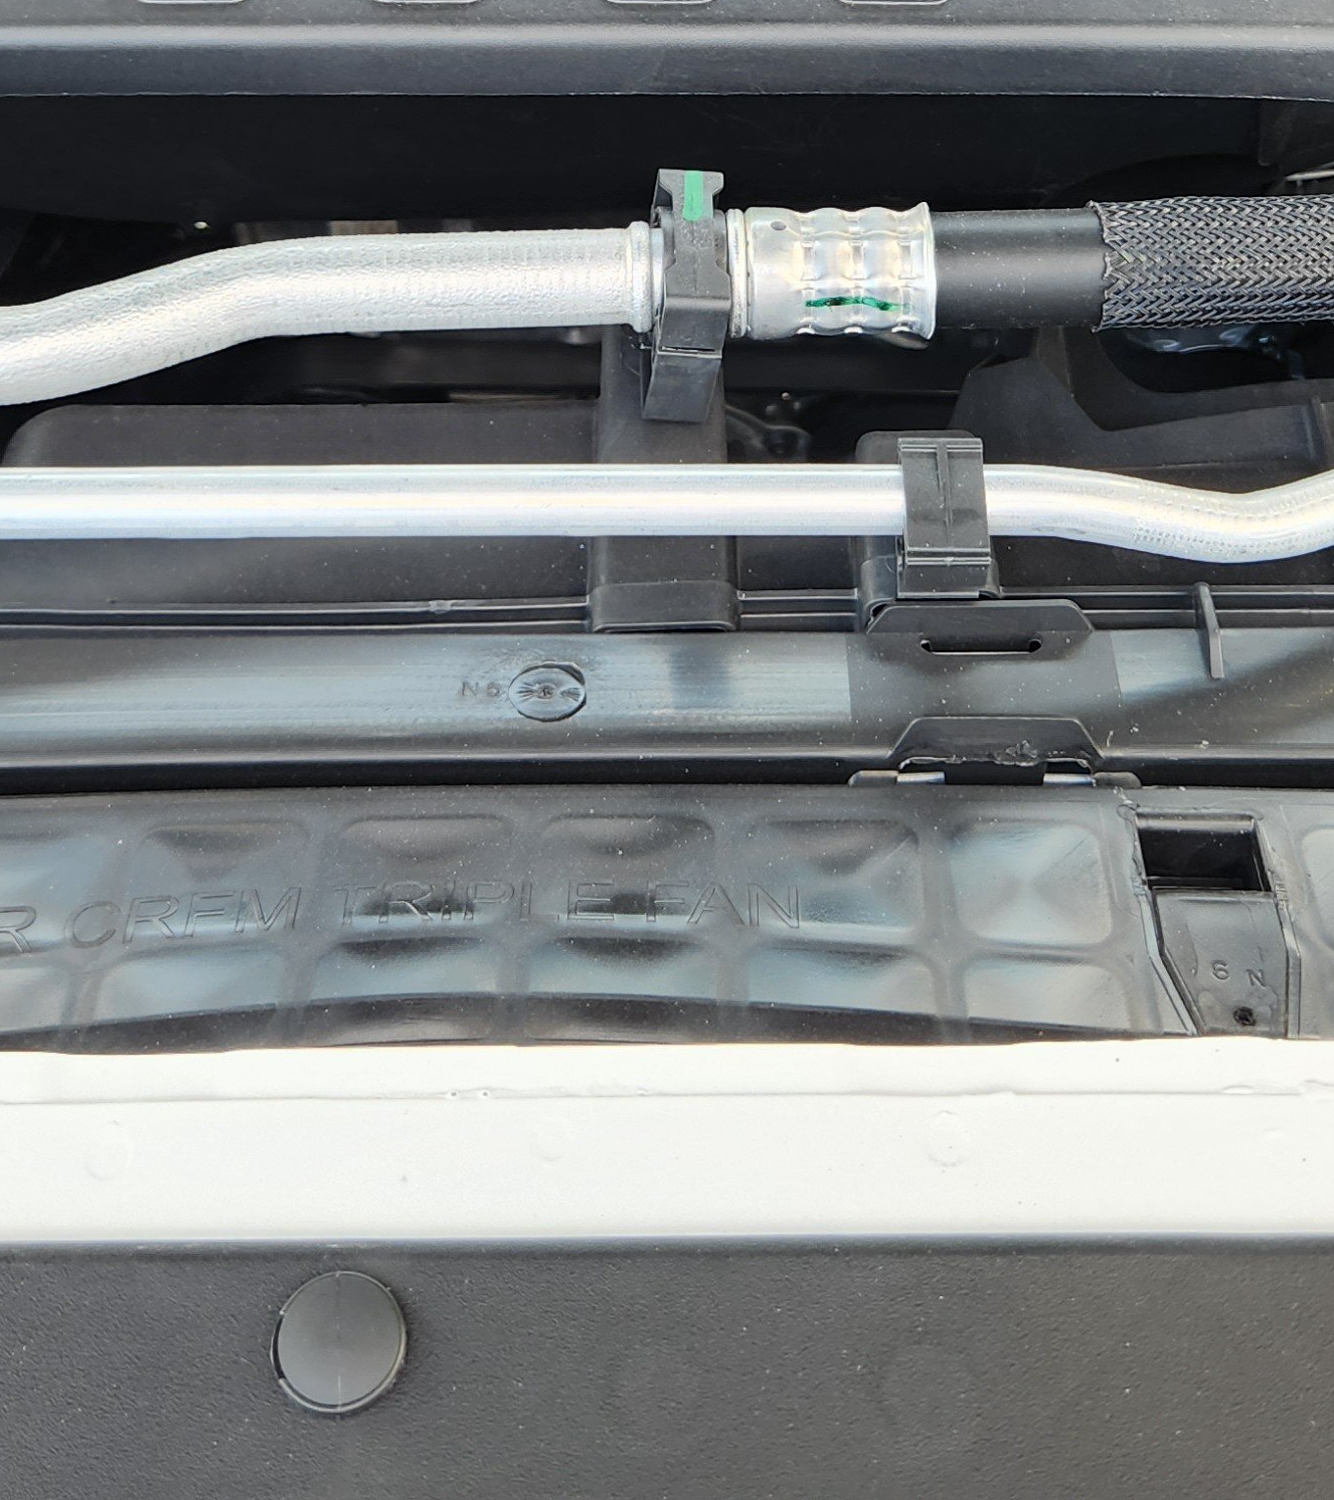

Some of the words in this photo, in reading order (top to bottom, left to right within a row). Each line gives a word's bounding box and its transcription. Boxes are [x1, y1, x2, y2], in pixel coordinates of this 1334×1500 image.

[65, 886, 302, 950] CRFM
[335, 880, 616, 925] TRIPLE
[645, 881, 802, 929] FAN
